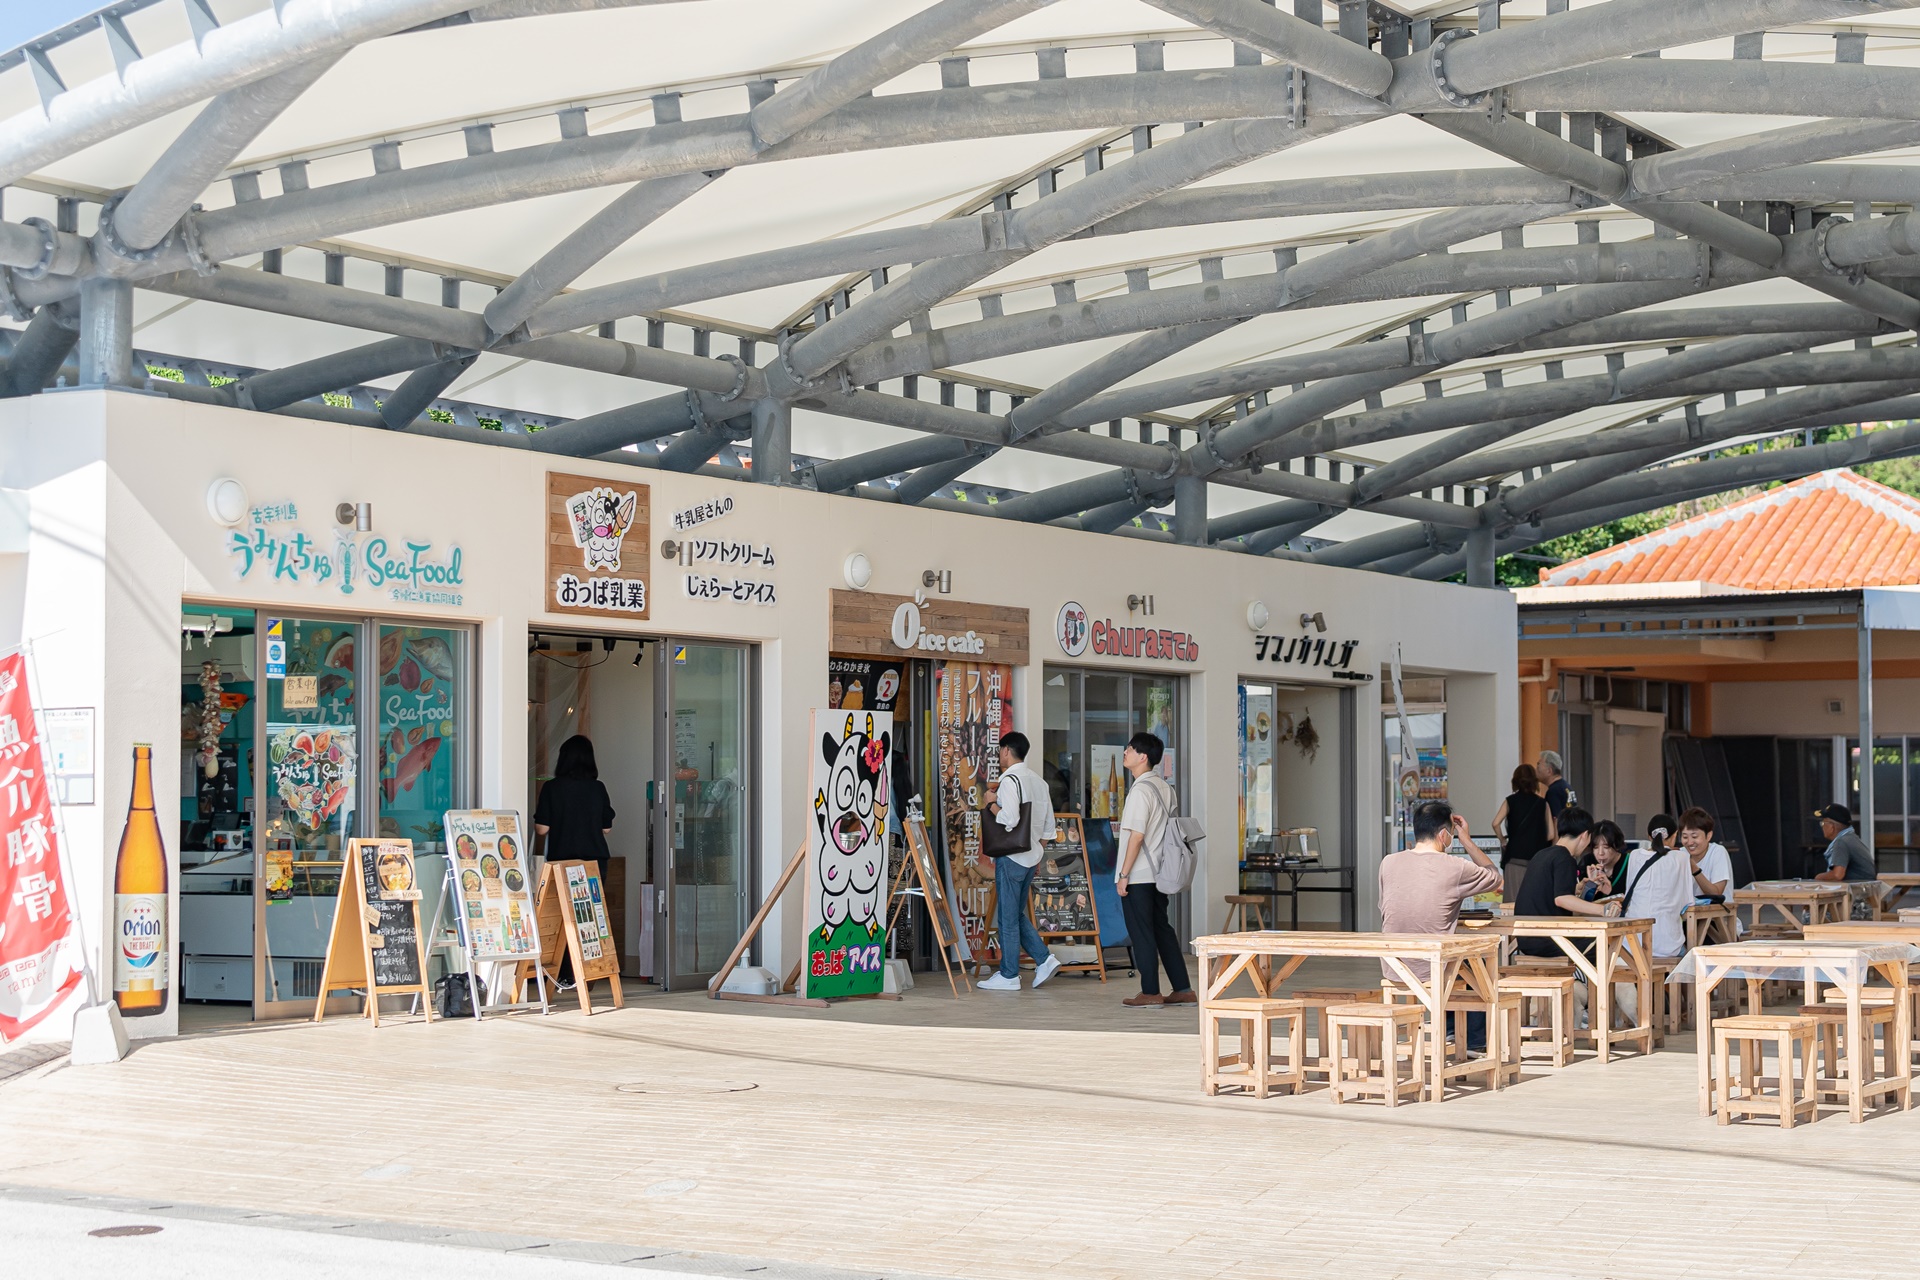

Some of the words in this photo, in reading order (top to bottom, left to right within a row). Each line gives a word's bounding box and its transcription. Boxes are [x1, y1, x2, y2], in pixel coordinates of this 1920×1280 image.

[252, 503, 297, 524] 古宇利島
[675, 497, 733, 529] 牛乳屋さんの
[232, 528, 332, 582] うみんちゅ
[696, 540, 775, 567] ソフトクリーム
[561, 577, 643, 609] おっぱ乳業
[687, 575, 776, 603] じぇらーとアイス
[986, 670, 1002, 783] 沖縄県産
[964, 670, 981, 867] フルーツ&野菜
[129, 941, 138, 950] THE
[139, 941, 154, 950] DRAFT
[811, 945, 847, 976] おっぱ
[848, 943, 881, 973] アイス
